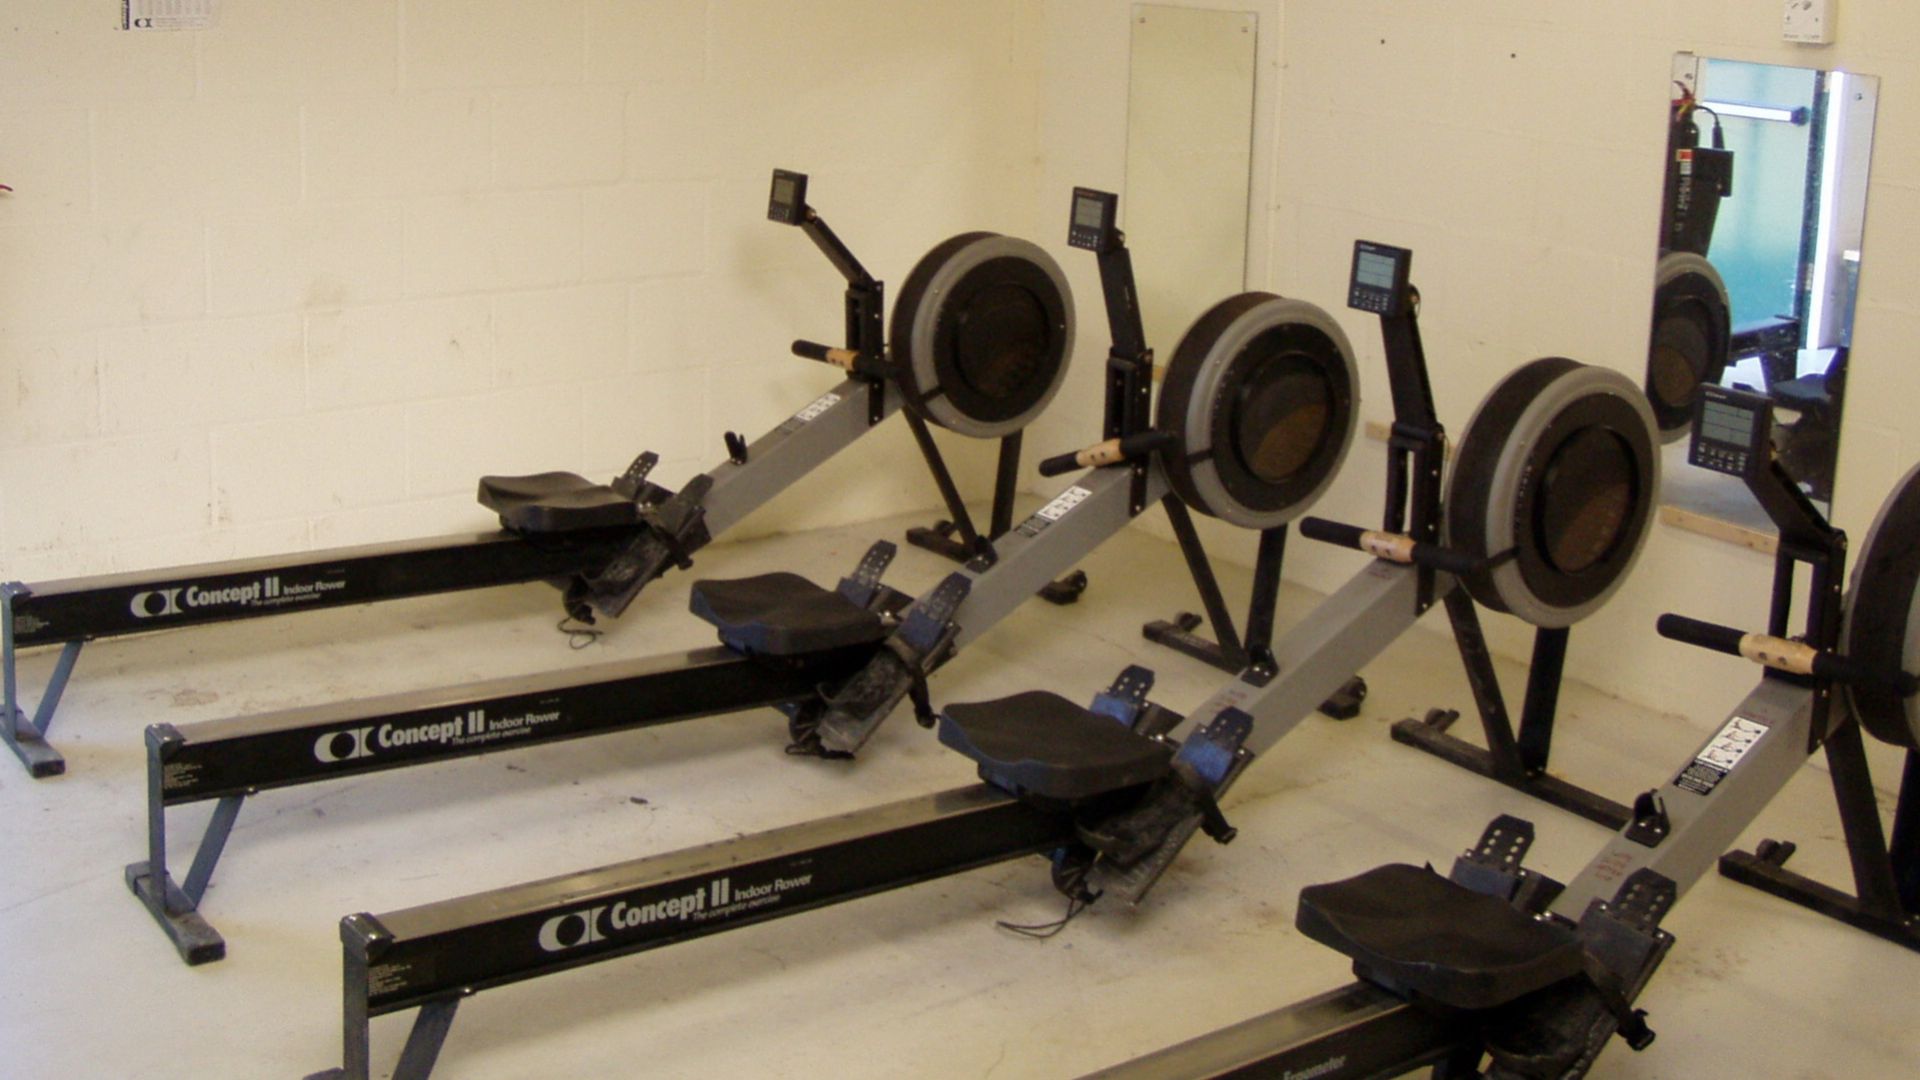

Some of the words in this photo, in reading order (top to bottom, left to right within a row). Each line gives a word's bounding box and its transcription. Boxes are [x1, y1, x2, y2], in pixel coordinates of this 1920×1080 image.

[185, 581, 261, 608] Concept
[264, 576, 280, 598] II
[283, 583, 314, 595] Indoor
[315, 580, 346, 592] Rower
[378, 715, 464, 749] Concept
[467, 709, 486, 735] II
[489, 718, 524, 732] Indoor
[525, 711, 561, 726] Rower
[451, 735, 465, 746] The
[466, 730, 501, 745] complete
[610, 887, 706, 930] Concept
[711, 877, 730, 907] II
[734, 883, 773, 902] Indoor
[774, 874, 813, 892] Rower
[693, 911, 707, 921] The
[708, 901, 747, 917] complete
